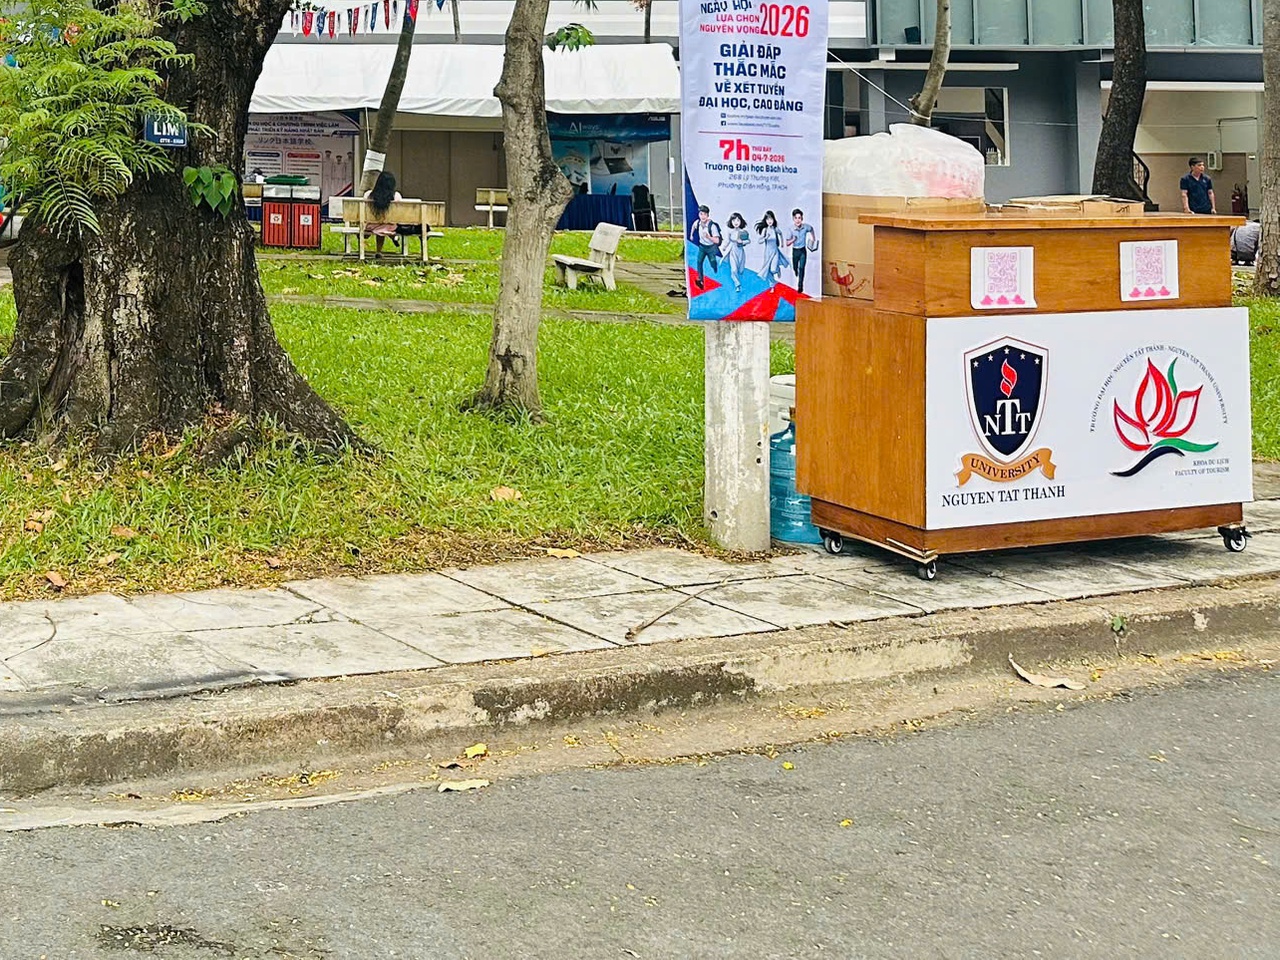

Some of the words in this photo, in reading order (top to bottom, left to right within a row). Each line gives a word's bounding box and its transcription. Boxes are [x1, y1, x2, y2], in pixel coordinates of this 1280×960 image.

[760, 2, 810, 38] 2026
[719, 40, 754, 58] GIẢI
[757, 43, 782, 60] ĐÁP
[713, 58, 757, 77] THẮC
[760, 60, 787, 80] MẮC
[714, 79, 731, 93] VỀ
[734, 80, 756, 94] XÉT
[757, 82, 785, 96] TUYỂN
[698, 96, 718, 109] ĐẠI
[721, 97, 751, 110] HỌC,
[753, 98, 773, 110] CAO
[774, 97, 804, 112] ĐẲNG
[153, 121, 180, 136] LIM
[719, 138, 750, 161] 7h
[704, 162, 734, 173] Trường
[736, 162, 750, 173] Đại
[750, 163, 764, 174] học
[765, 164, 780, 173] Bách
[984, 397, 1032, 436] NTT
[970, 453, 1041, 479] UNIVERSITY
[942, 490, 995, 507] NGUYEN
[998, 489, 1020, 503] TAT
[1022, 485, 1066, 501] THANH
